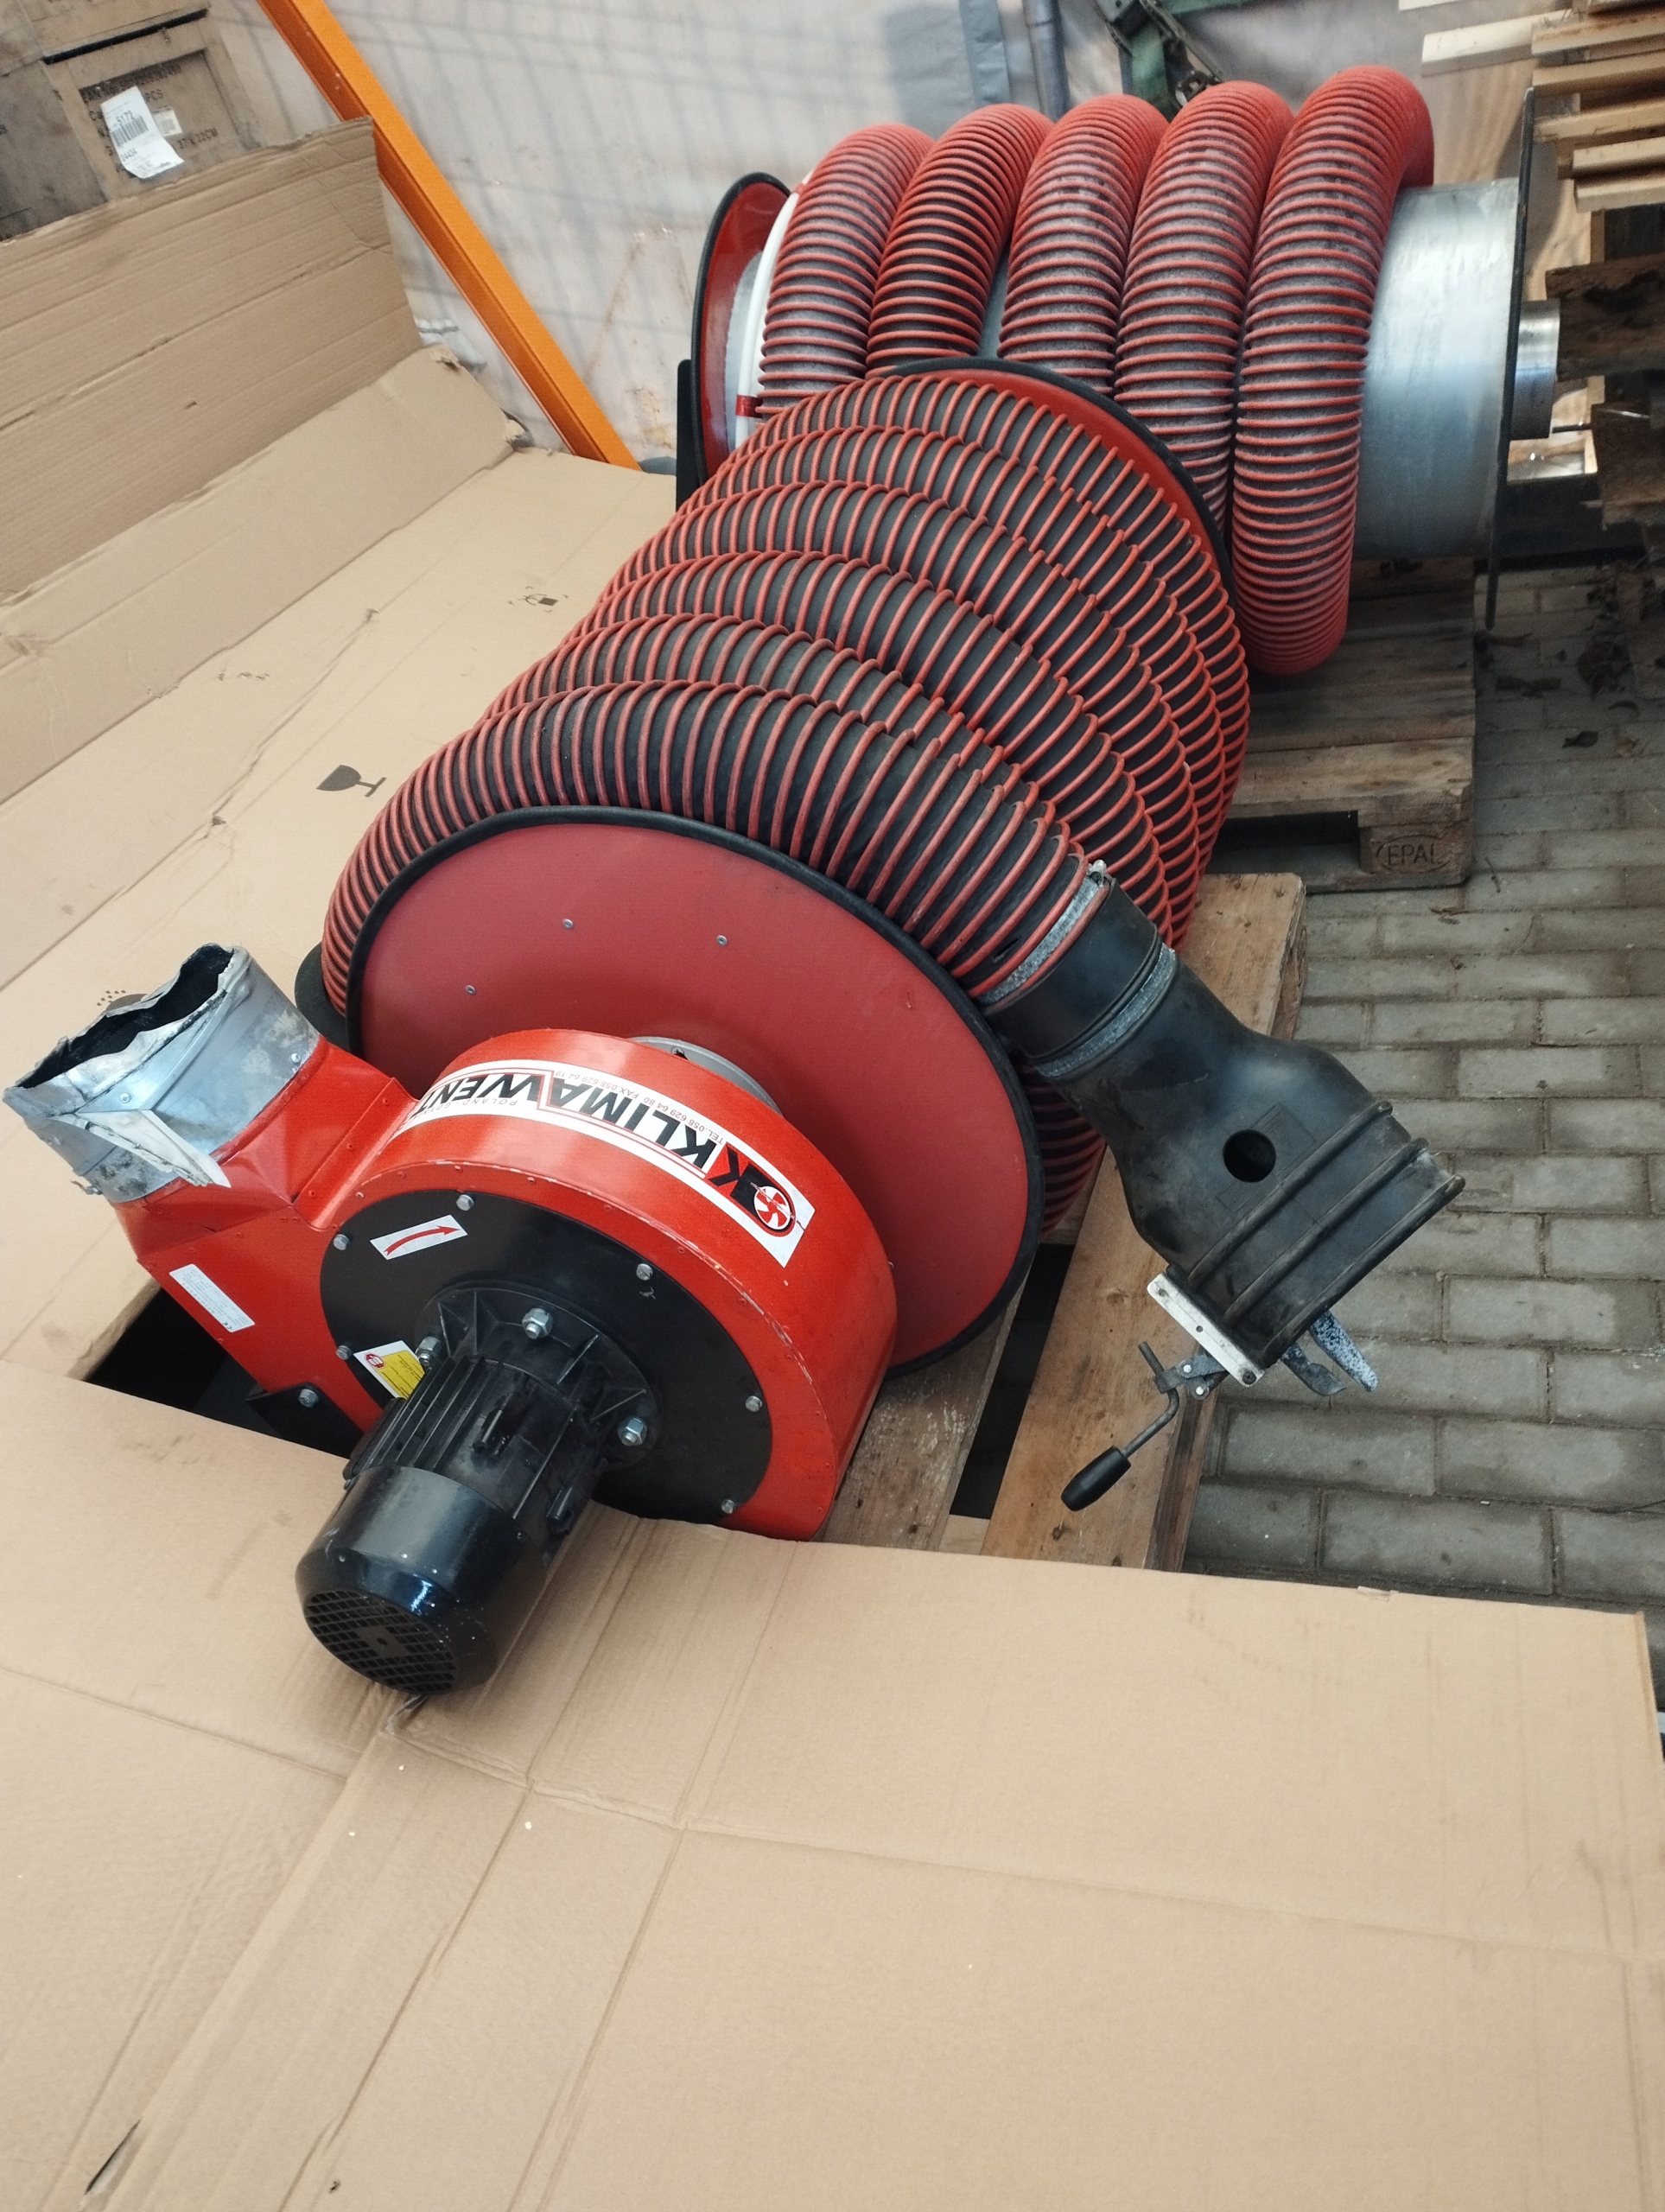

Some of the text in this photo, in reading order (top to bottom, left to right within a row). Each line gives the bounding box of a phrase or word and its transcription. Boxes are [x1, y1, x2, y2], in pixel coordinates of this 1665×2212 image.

[1388, 842, 1444, 867] EPAL
[581, 1076, 599, 1084] 629
[462, 1097, 518, 1106] POLAND
[643, 1096, 656, 1106] 80
[657, 1102, 670, 1113] 64
[670, 1109, 688, 1122] 629
